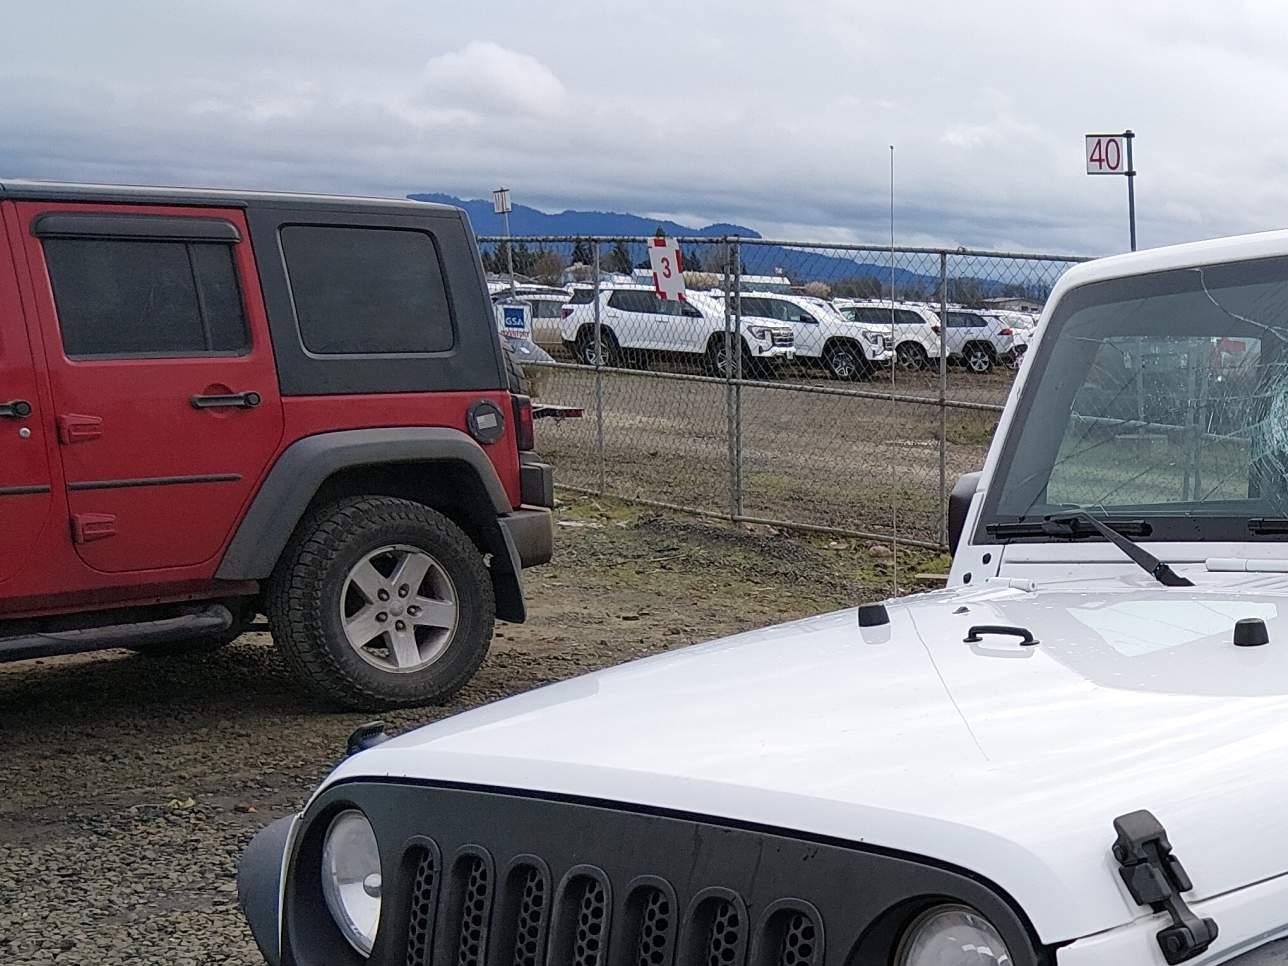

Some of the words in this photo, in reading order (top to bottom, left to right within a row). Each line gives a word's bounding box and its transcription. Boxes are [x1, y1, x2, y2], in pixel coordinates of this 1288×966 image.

[1090, 138, 1121, 170] 40
[661, 257, 672, 279] 3
[505, 316, 524, 326] GSA
